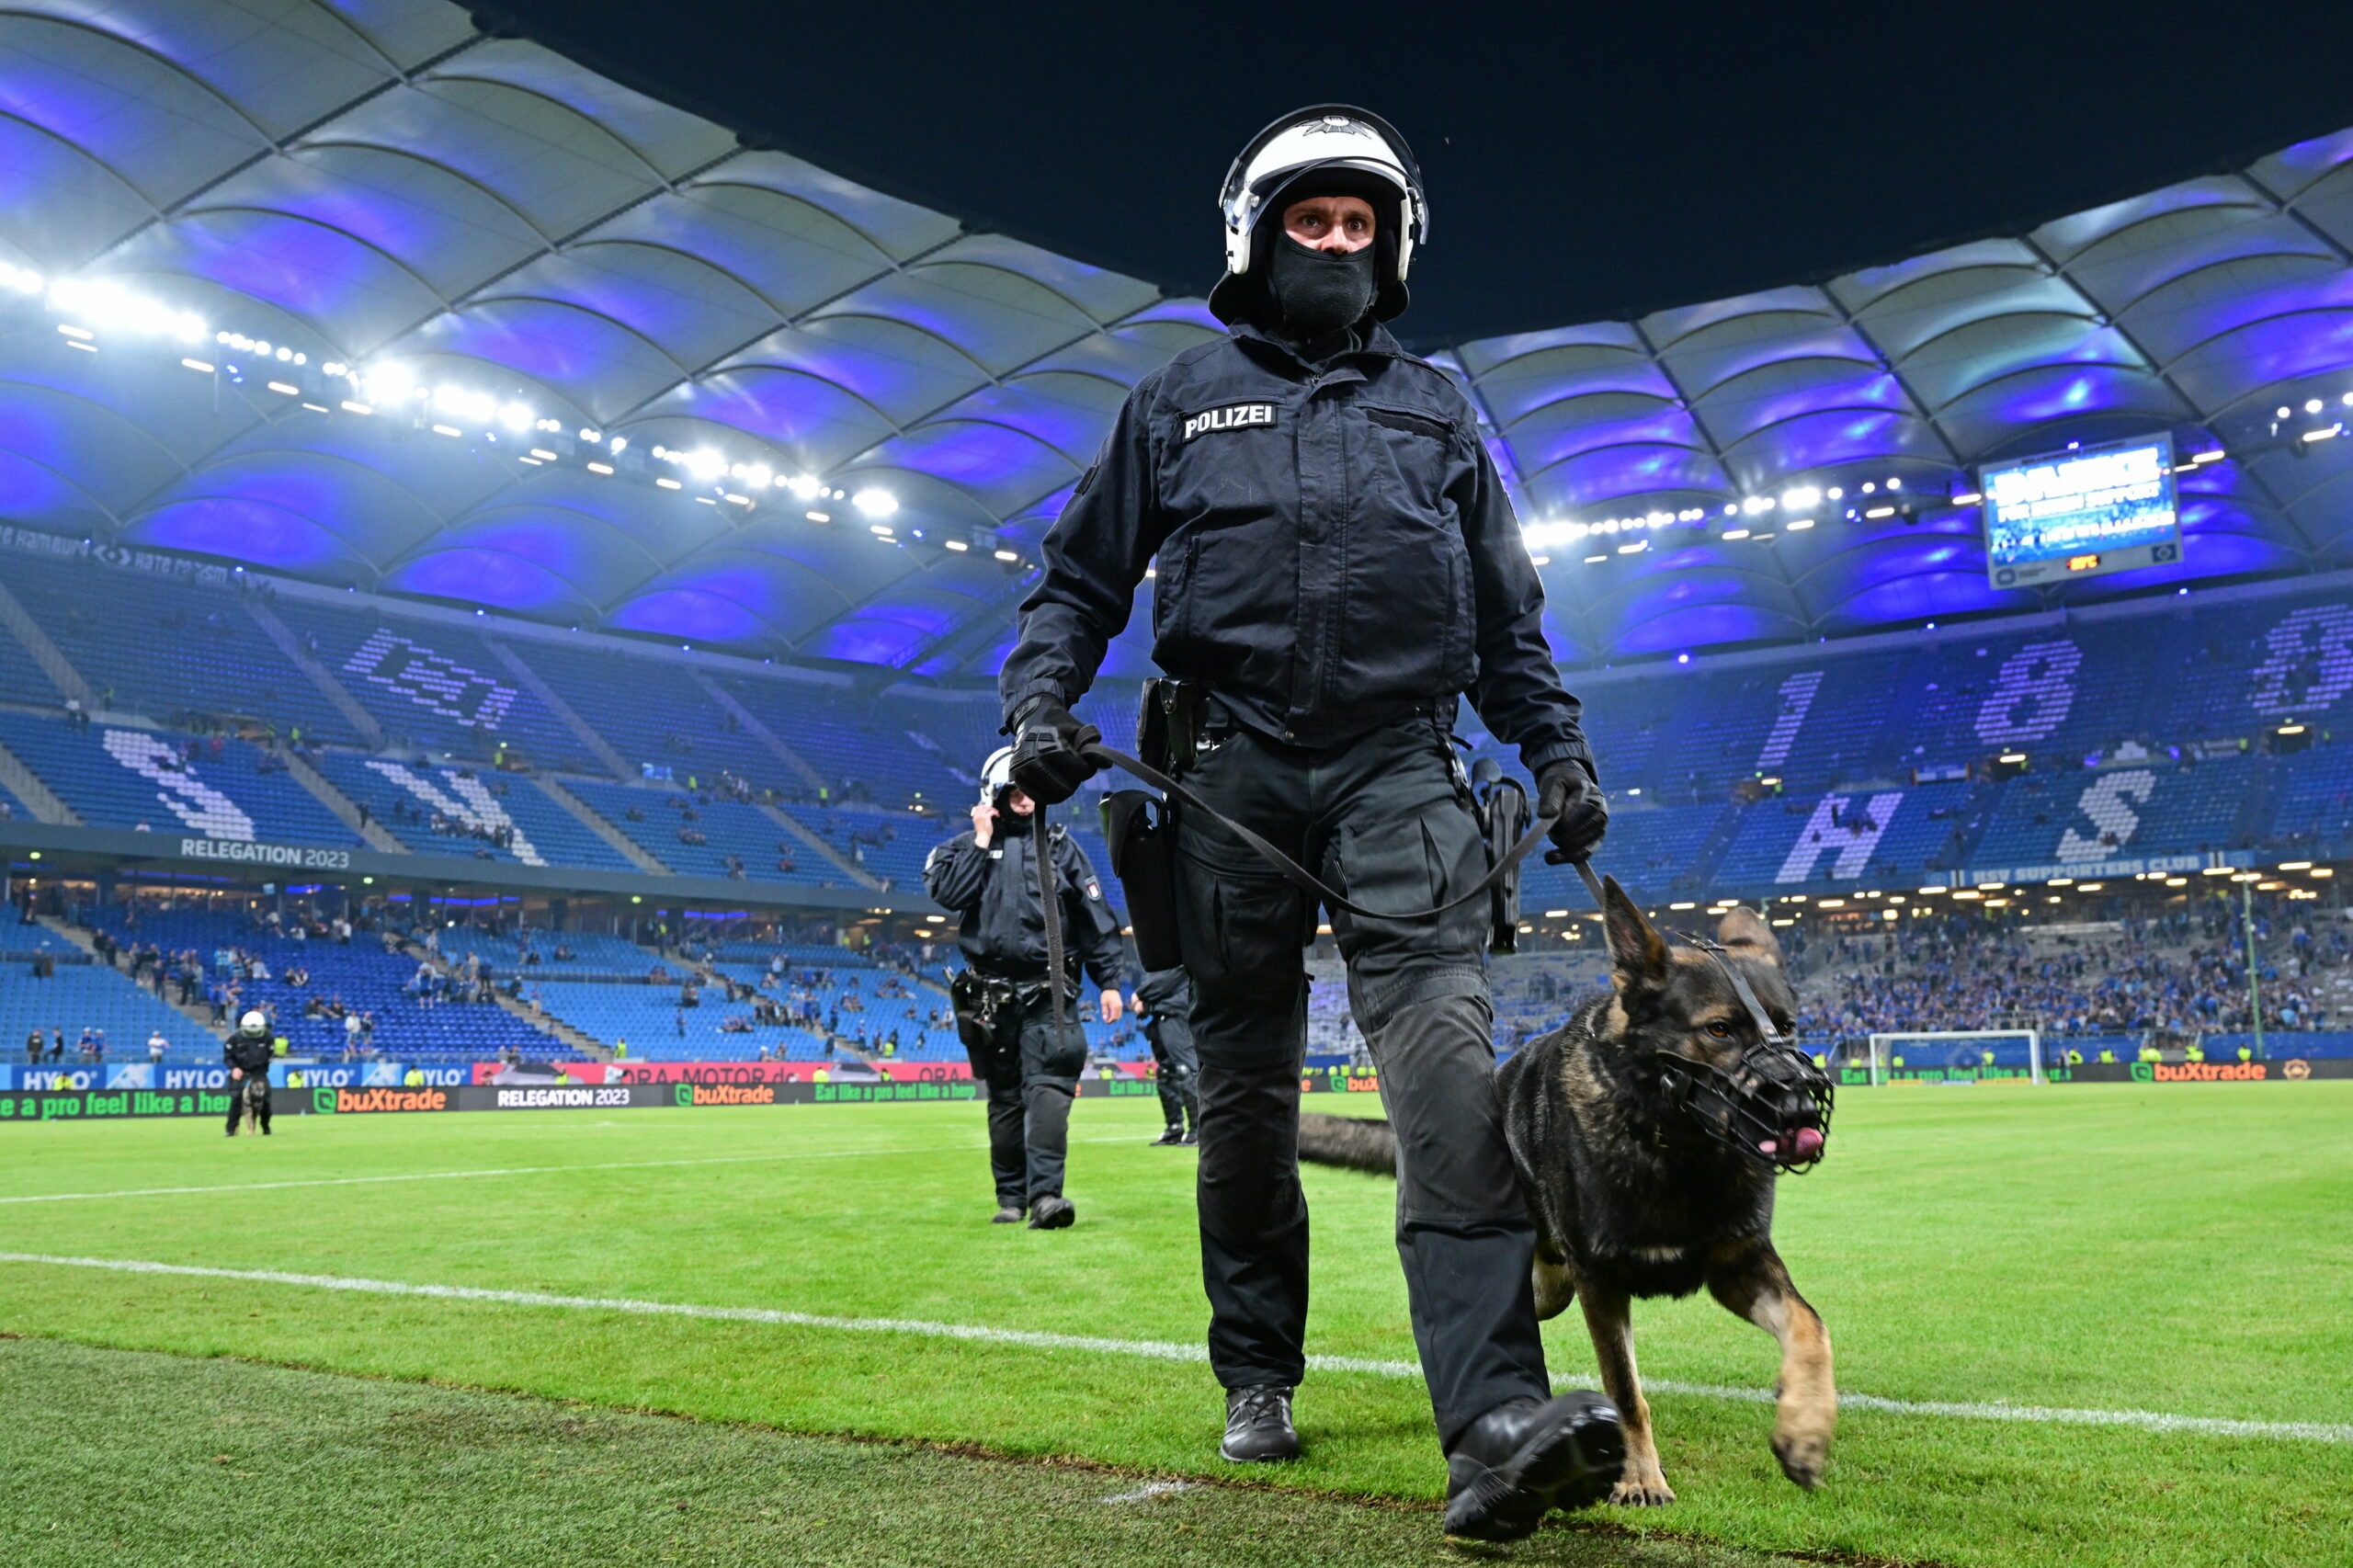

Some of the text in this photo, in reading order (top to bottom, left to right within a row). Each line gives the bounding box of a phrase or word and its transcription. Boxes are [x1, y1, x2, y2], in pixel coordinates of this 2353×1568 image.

[1184, 404, 1272, 439] POLIZEI
[181, 838, 349, 869] RELEGATION 2023
[2015, 859, 2144, 882] SUPPORTERS
[2147, 855, 2200, 873] CLUB
[23, 1070, 90, 1091] HYO
[2154, 1062, 2267, 1081] buXtrade
[336, 1087, 447, 1112] buXtrade
[497, 1088, 631, 1108] RELEGATION 2023
[693, 1084, 774, 1105] buXtrade
[815, 1083, 836, 1101] Eat
[838, 1083, 862, 1100] like
[20, 1096, 37, 1117] a
[41, 1096, 80, 1120] pro
[85, 1093, 129, 1115] feel
[133, 1091, 175, 1114] like
[179, 1095, 194, 1114] a
